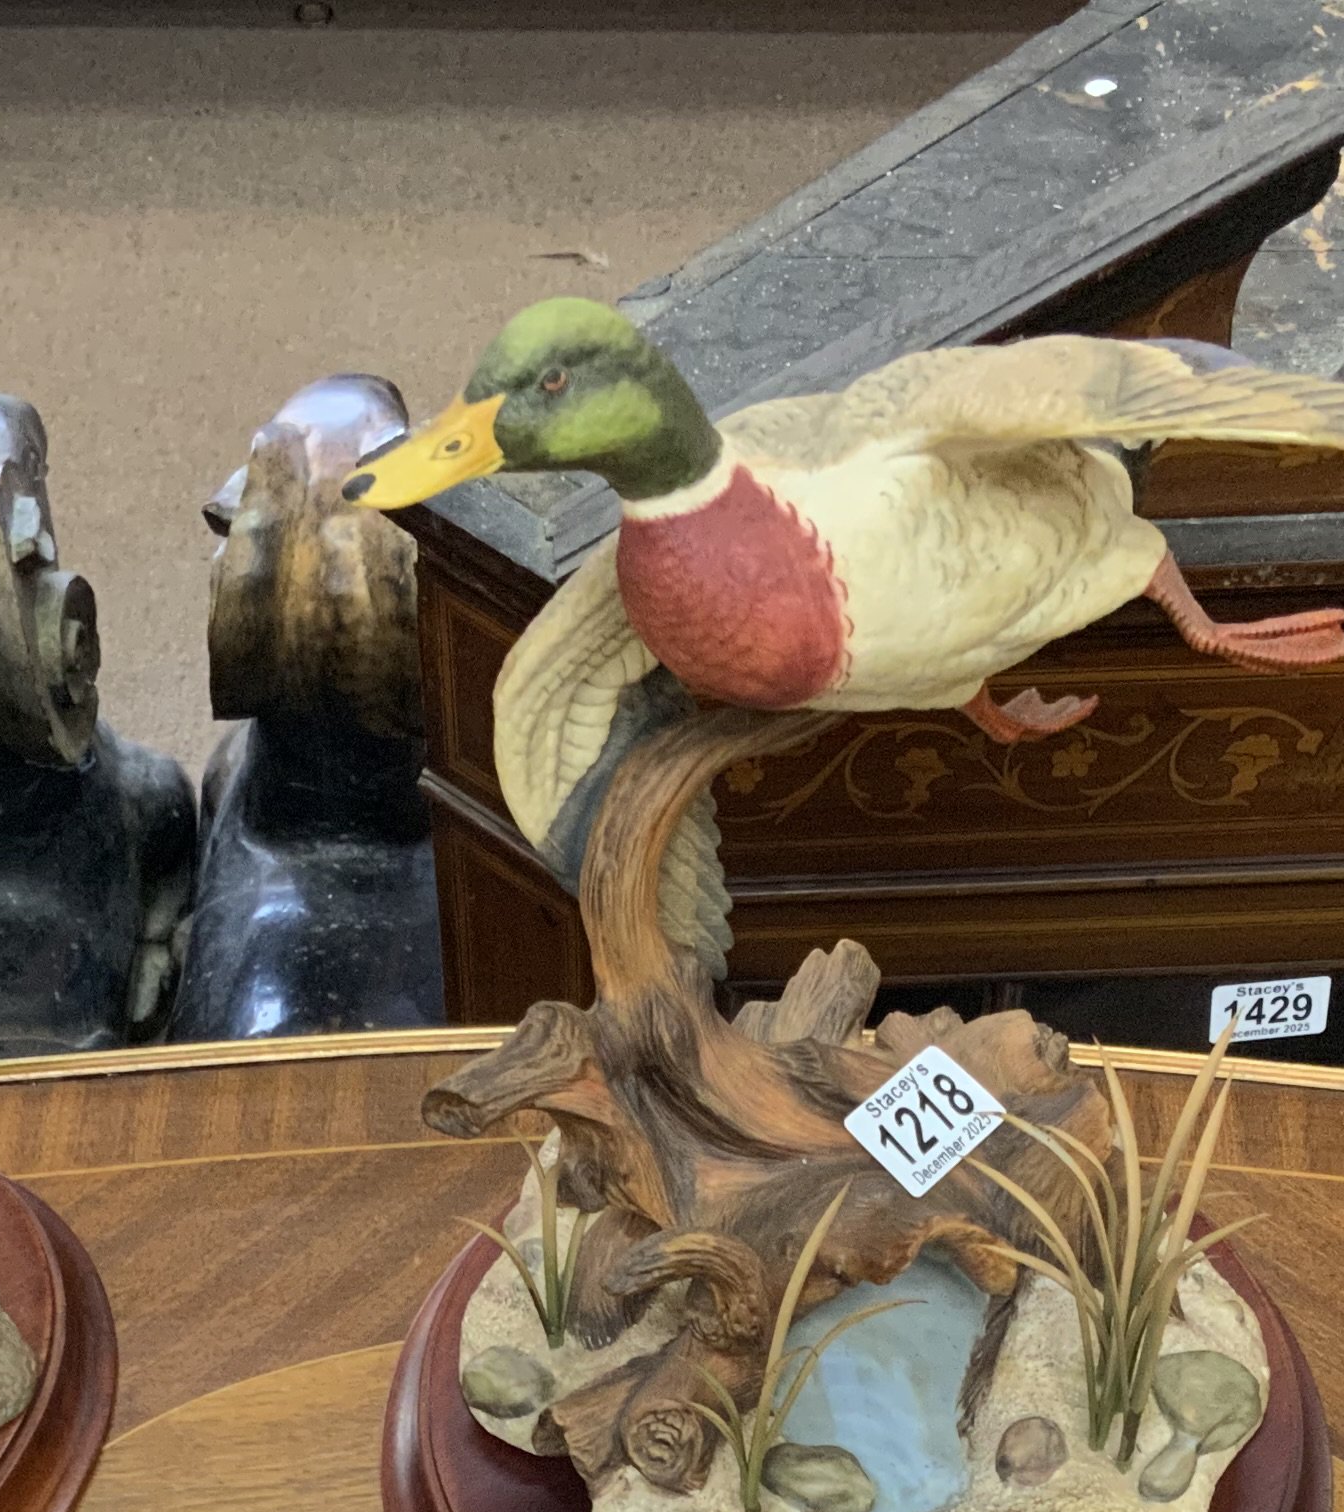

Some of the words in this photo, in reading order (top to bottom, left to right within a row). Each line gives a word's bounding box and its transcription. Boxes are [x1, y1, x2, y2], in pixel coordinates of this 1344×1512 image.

[1224, 993, 1312, 1025] 1429
[1236, 982, 1304, 997] Stacey's
[1231, 1027, 1280, 1038] ecember
[1283, 1022, 1310, 1033] 2025
[865, 1063, 929, 1118] Stacey's
[877, 1073, 974, 1165] 1218
[912, 1136, 966, 1186] December
[962, 1112, 992, 1141] 2025
